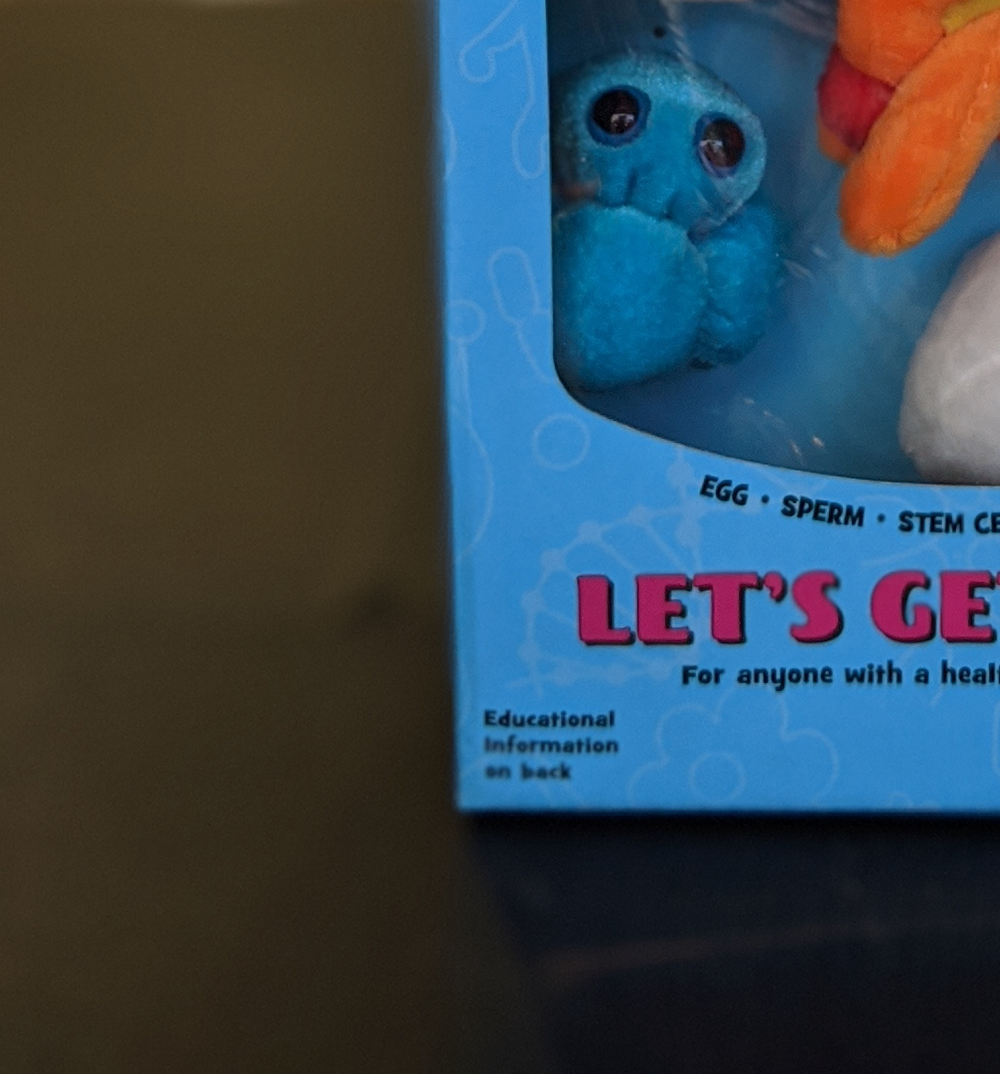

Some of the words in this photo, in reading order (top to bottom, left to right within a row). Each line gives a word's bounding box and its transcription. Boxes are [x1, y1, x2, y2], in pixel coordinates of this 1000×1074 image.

[699, 474, 749, 506] EGG
[780, 494, 866, 528] SPERM
[897, 509, 965, 534] STEM
[577, 571, 843, 645] LET'S
[681, 664, 725, 685] For
[736, 666, 834, 692] anyone
[844, 659, 903, 684] with
[914, 667, 929, 684] a
[484, 708, 615, 727] Educational
[484, 734, 618, 753] Information
[486, 766, 511, 779] on
[521, 762, 571, 780] back
